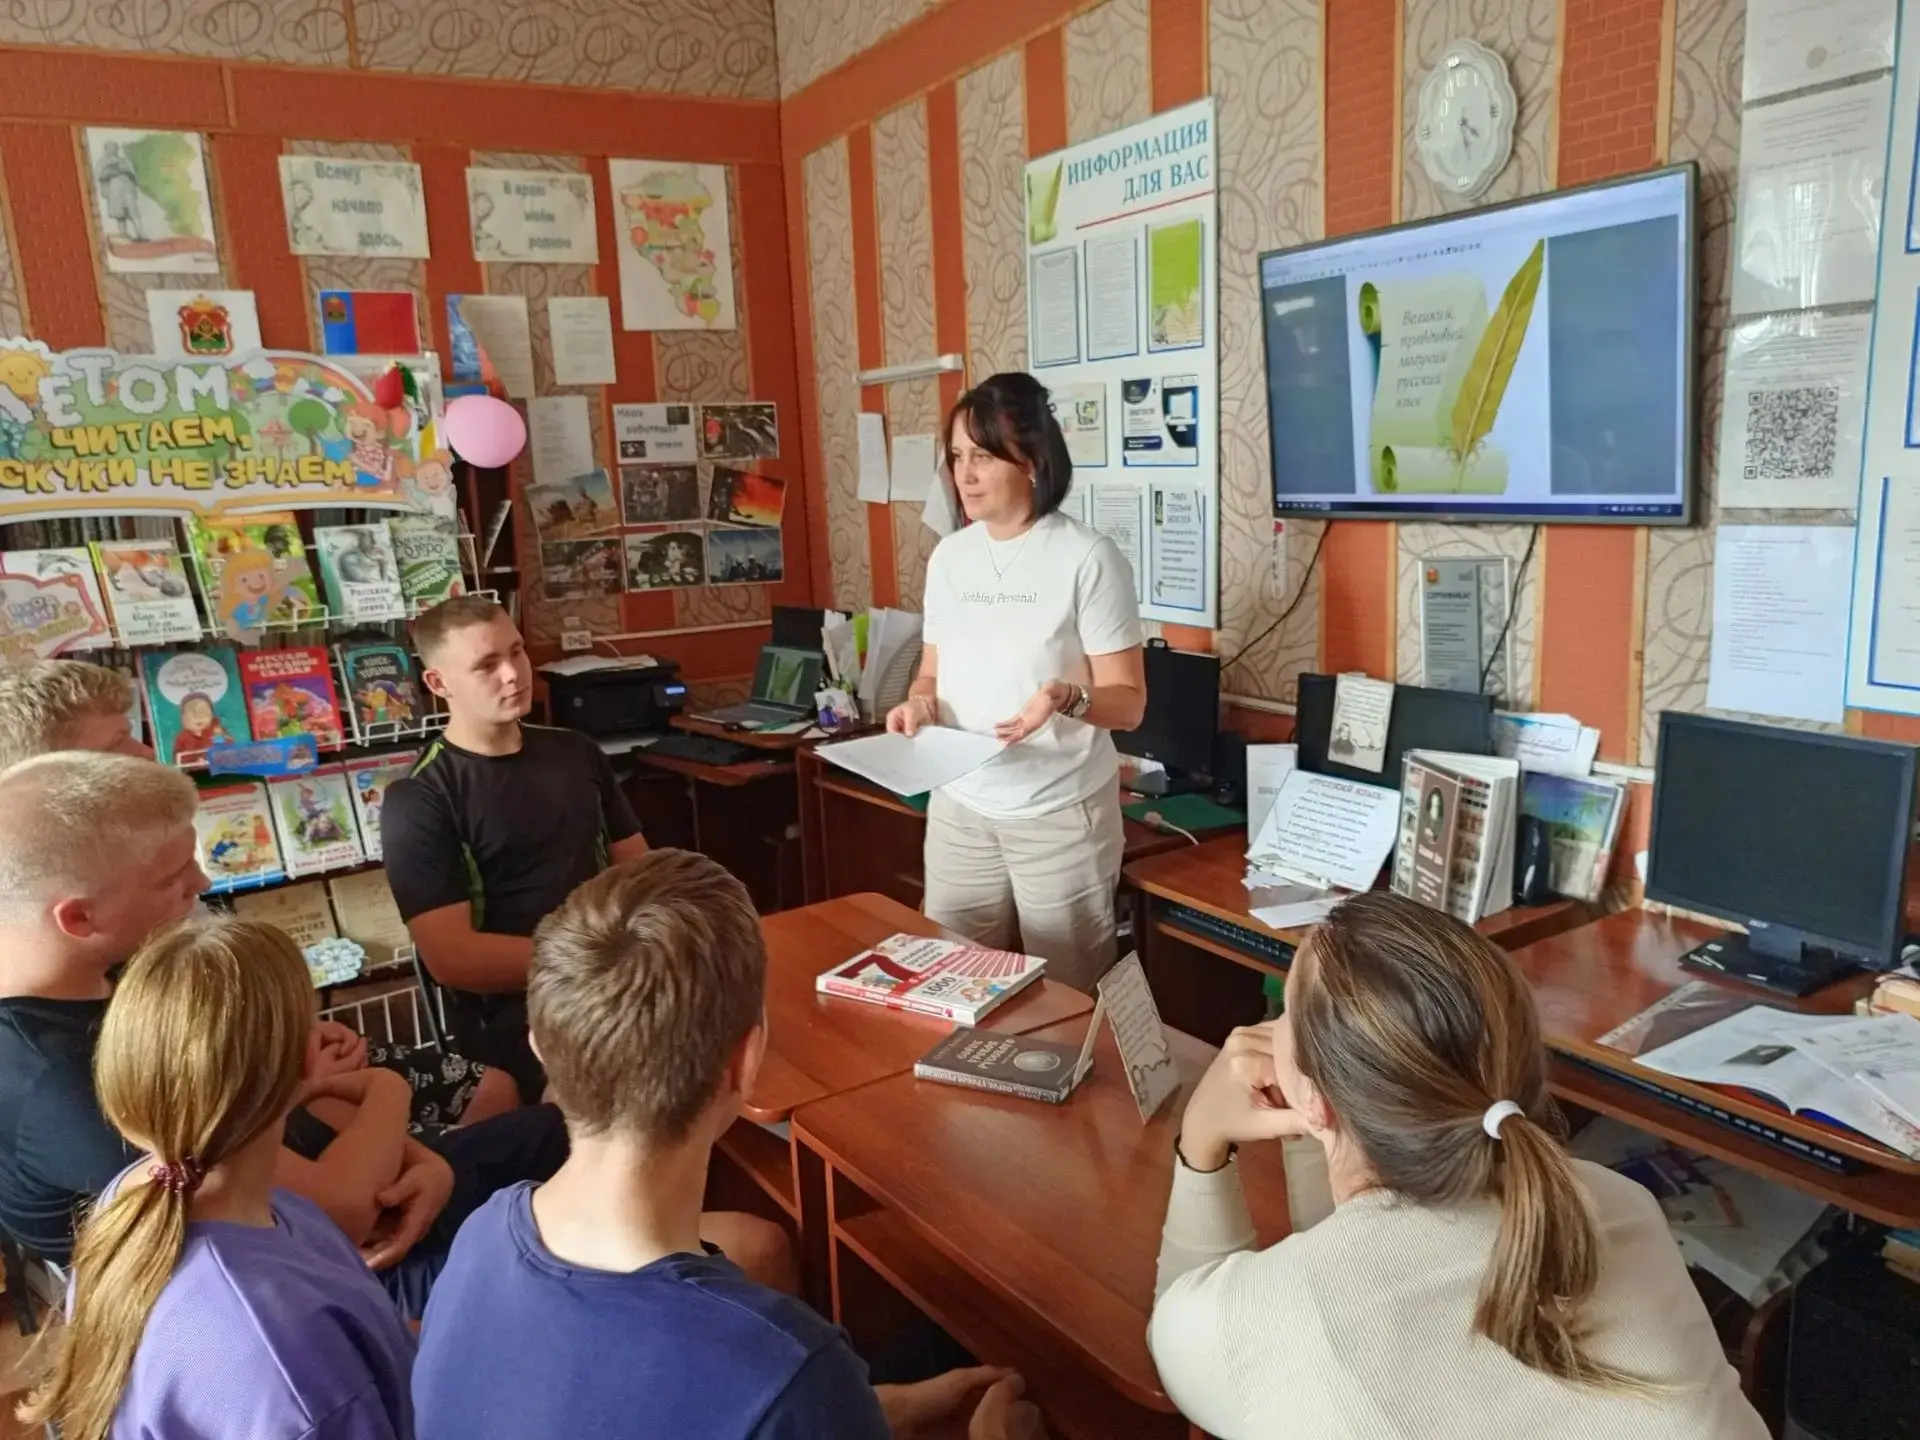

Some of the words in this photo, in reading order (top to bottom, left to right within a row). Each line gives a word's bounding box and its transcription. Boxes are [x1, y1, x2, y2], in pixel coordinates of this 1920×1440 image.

[1067, 119, 1209, 186] ИНФОРМАЦИЯ
[1122, 168, 1163, 204] ДЛЯ
[1170, 155, 1209, 188] ВАС
[332, 198, 384, 214] начало
[51, 416, 251, 457] ЧИТАЕМ,
[0, 458, 138, 493] СКУКИ
[150, 458, 214, 490] НЕ
[223, 455, 357, 489] ЗНАЕМ
[961, 592, 994, 606] Nothing
[996, 592, 1037, 603] Personal
[922, 976, 956, 996] 1000
